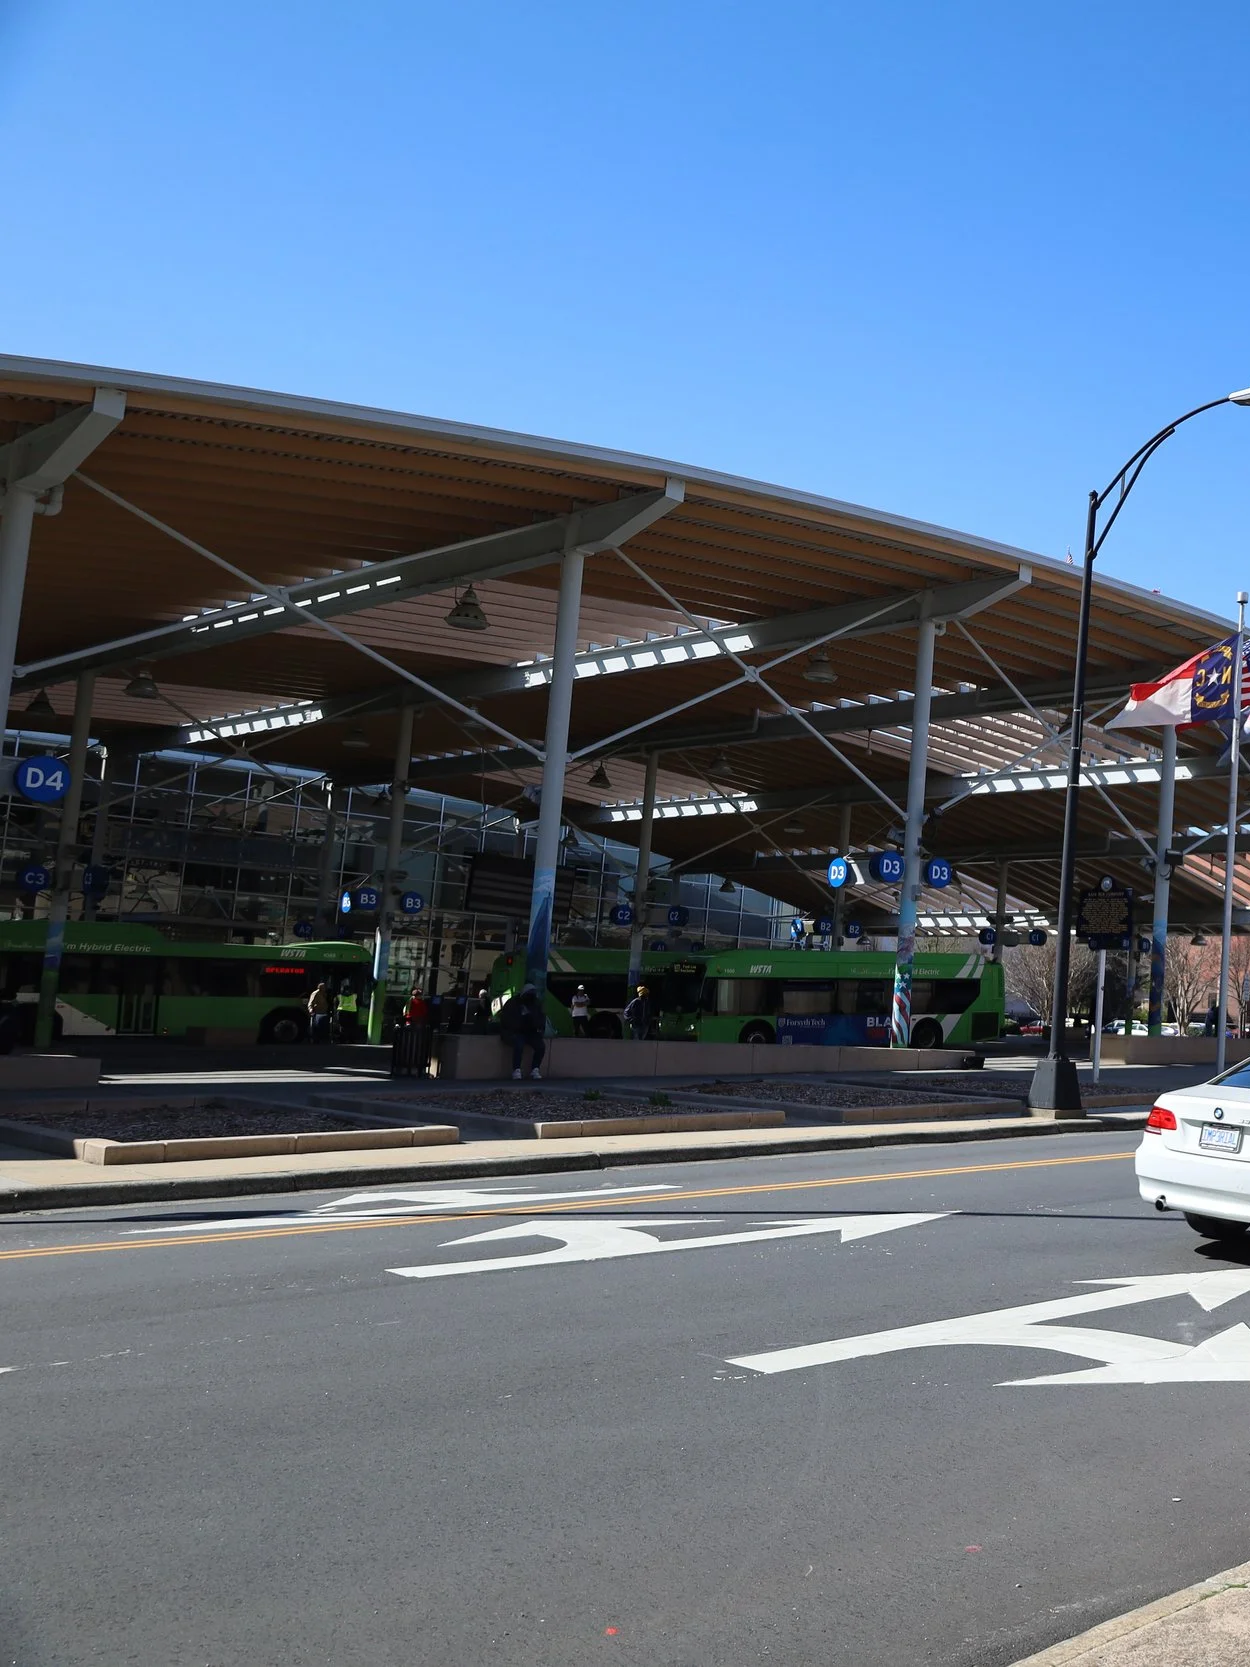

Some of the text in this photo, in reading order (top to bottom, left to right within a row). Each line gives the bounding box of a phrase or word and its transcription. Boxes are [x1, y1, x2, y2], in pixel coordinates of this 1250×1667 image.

[25, 766, 64, 792] D4
[830, 865, 845, 880] D3
[882, 860, 900, 875] D3
[24, 872, 45, 885] C3
[932, 867, 949, 881] D3
[360, 893, 377, 905] B3
[405, 897, 421, 909] B3
[617, 911, 631, 921] C2
[669, 911, 680, 921] C2
[820, 921, 832, 932] B2
[849, 924, 860, 934] B2
[79, 942, 112, 952] Hybrid
[114, 943, 151, 953] Electric
[280, 948, 306, 958] WSTA
[749, 964, 773, 974] WSTA
